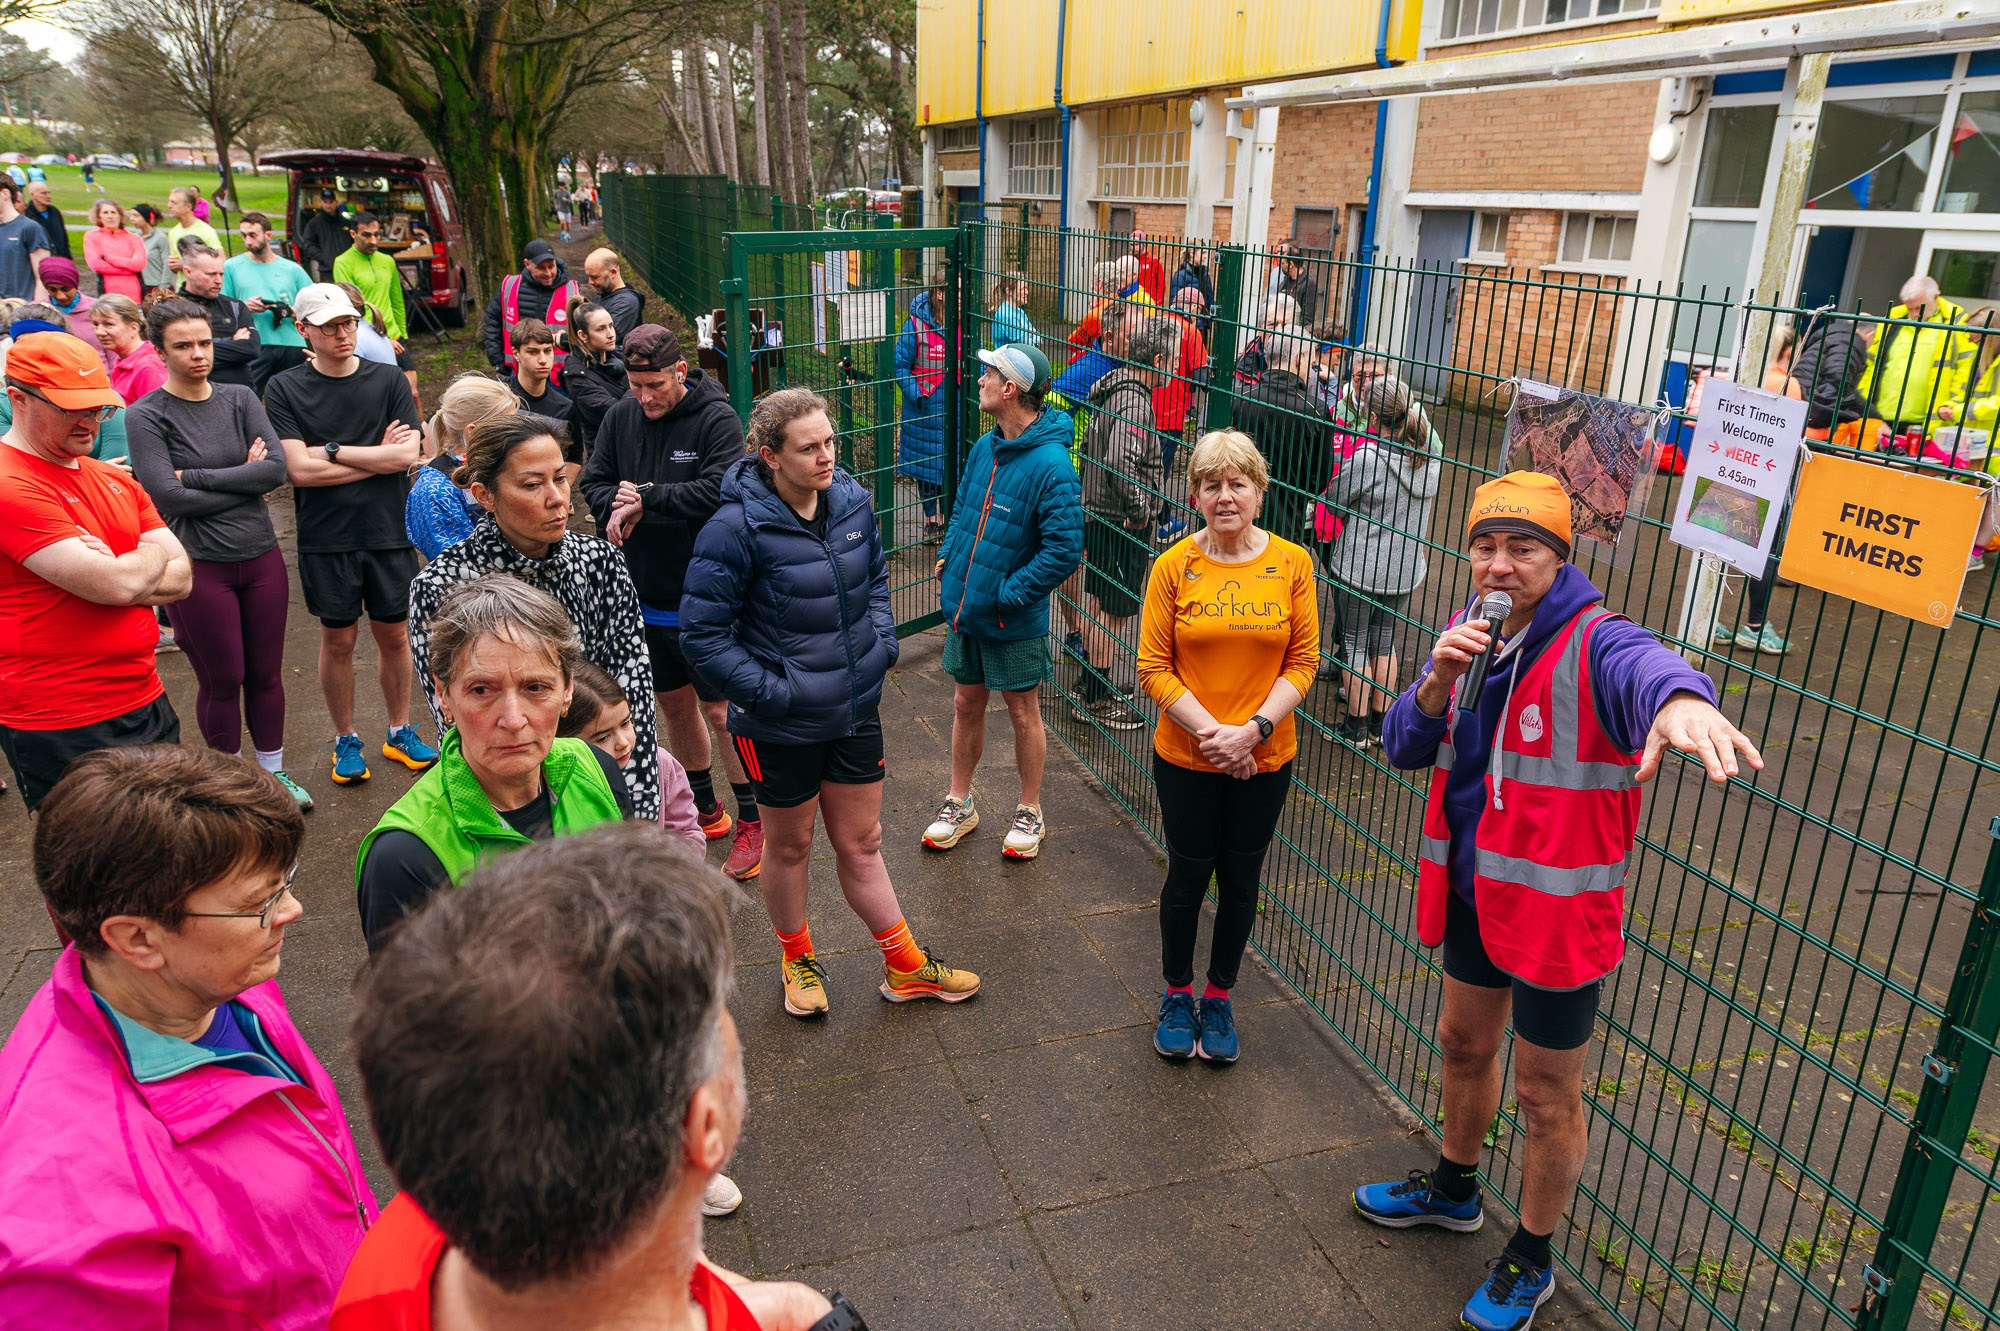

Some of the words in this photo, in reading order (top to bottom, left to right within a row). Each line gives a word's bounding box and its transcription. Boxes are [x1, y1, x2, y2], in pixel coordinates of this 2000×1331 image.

[1717, 398, 1745, 417] First
[1749, 405, 1786, 429] Timers
[1722, 420, 1774, 447] Welcome
[1724, 446, 1760, 467] HERE
[1718, 466, 1756, 488] 8.45am
[1476, 497, 1530, 518] parkrun
[1839, 502, 1920, 539] FIRST
[1821, 531, 1924, 577] TIMERS
[1187, 580, 1282, 622] parkrun
[1228, 623, 1264, 631] finsbury
